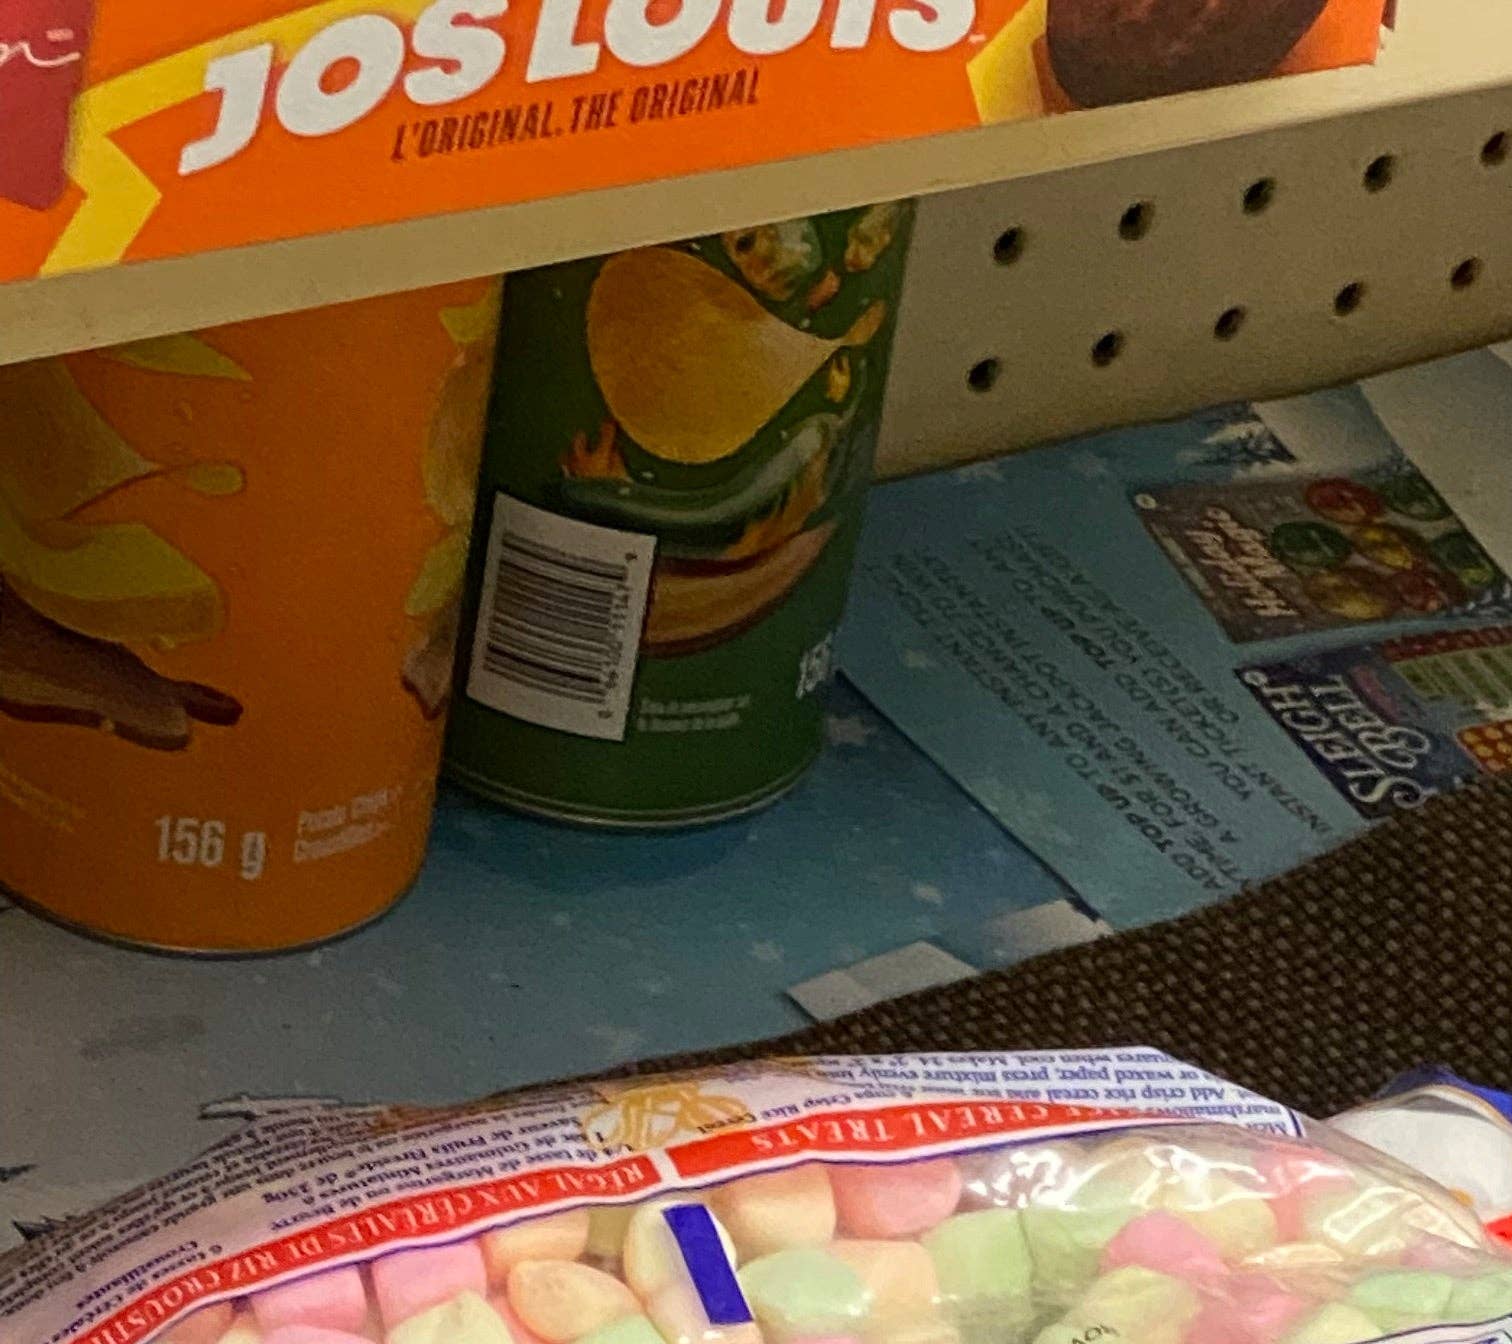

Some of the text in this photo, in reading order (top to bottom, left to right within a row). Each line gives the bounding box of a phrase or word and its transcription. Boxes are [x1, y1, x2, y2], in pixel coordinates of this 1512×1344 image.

[178, 0, 977, 176] JOS LOUIS
[570, 91, 623, 133] THE
[628, 66, 760, 125] ORIGINAL
[1010, 576, 1046, 601] TO
[1038, 603, 1078, 630] UP
[956, 621, 1052, 700] CHANCE
[1067, 631, 1116, 667] TOP
[1092, 623, 1145, 661] YOU
[1111, 673, 1167, 715] ADD
[1196, 695, 1240, 725] OR
[1021, 714, 1070, 750] ANY
[1157, 716, 1212, 757] CAN
[1261, 667, 1425, 809] SLEIGH
[1312, 675, 1429, 773] BELL
[1019, 650, 1239, 849] A GROWING JACKPOT
[1063, 722, 1119, 764] AND
[1062, 753, 1102, 781] TO
[1203, 760, 1253, 797] YOU
[1093, 782, 1132, 809] UP
[1132, 788, 1187, 828] FOR
[1235, 758, 1332, 838] INSTANT
[153, 814, 266, 880] 156 g
[1122, 810, 1175, 849] TOP
[1167, 853, 1222, 894] ADD
[922, 1068, 996, 1084] mixture
[1000, 1066, 1048, 1083] press
[1114, 1066, 1172, 1084] waxed
[1141, 1083, 1184, 1102] crisp
[1190, 1085, 1224, 1100] Add
[761, 1103, 799, 1119] Rice
[1046, 1086, 1098, 1105] cereal
[1104, 1087, 1135, 1103] rice
[748, 1116, 894, 1153] TREATS
[907, 1103, 1048, 1138] CEREAL
[476, 1177, 541, 1211] AUX
[222, 1246, 277, 1285] RIZ
